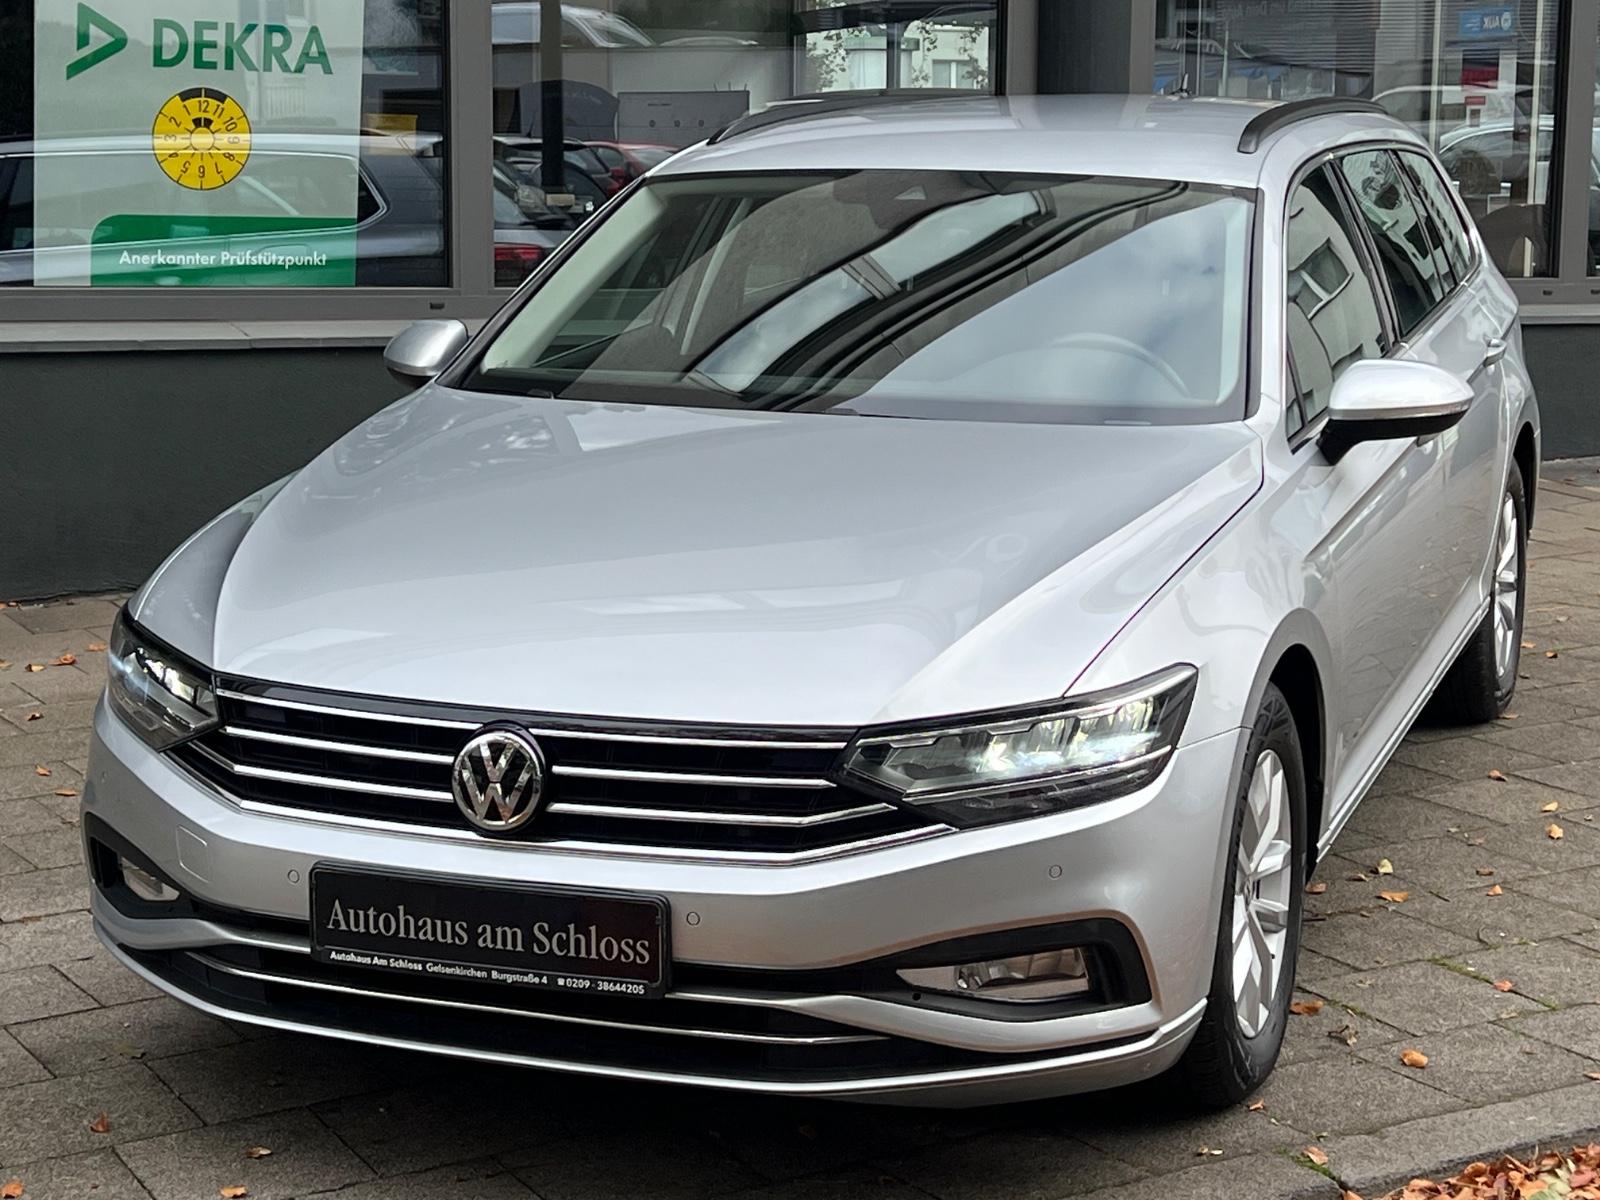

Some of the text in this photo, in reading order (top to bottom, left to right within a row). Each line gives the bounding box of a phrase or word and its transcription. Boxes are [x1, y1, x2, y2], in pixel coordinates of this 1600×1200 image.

[152, 18, 334, 76] DEKRA
[183, 104, 191, 116] 1
[198, 100, 210, 113] 12
[212, 104, 225, 119] 11
[168, 116, 182, 128] 2
[223, 116, 238, 132] 10
[163, 134, 177, 142] 3
[223, 151, 236, 162] 8
[180, 160, 192, 174] 5
[214, 161, 223, 175] 7
[119, 250, 327, 270] Anerkannter Prüfstützpunkt
[327, 898, 650, 965] Autohaus am Schloss
[330, 950, 645, 995] Autohaus Am Schloss Gelsenkirchen Burgstraße 4 0209 38644205
